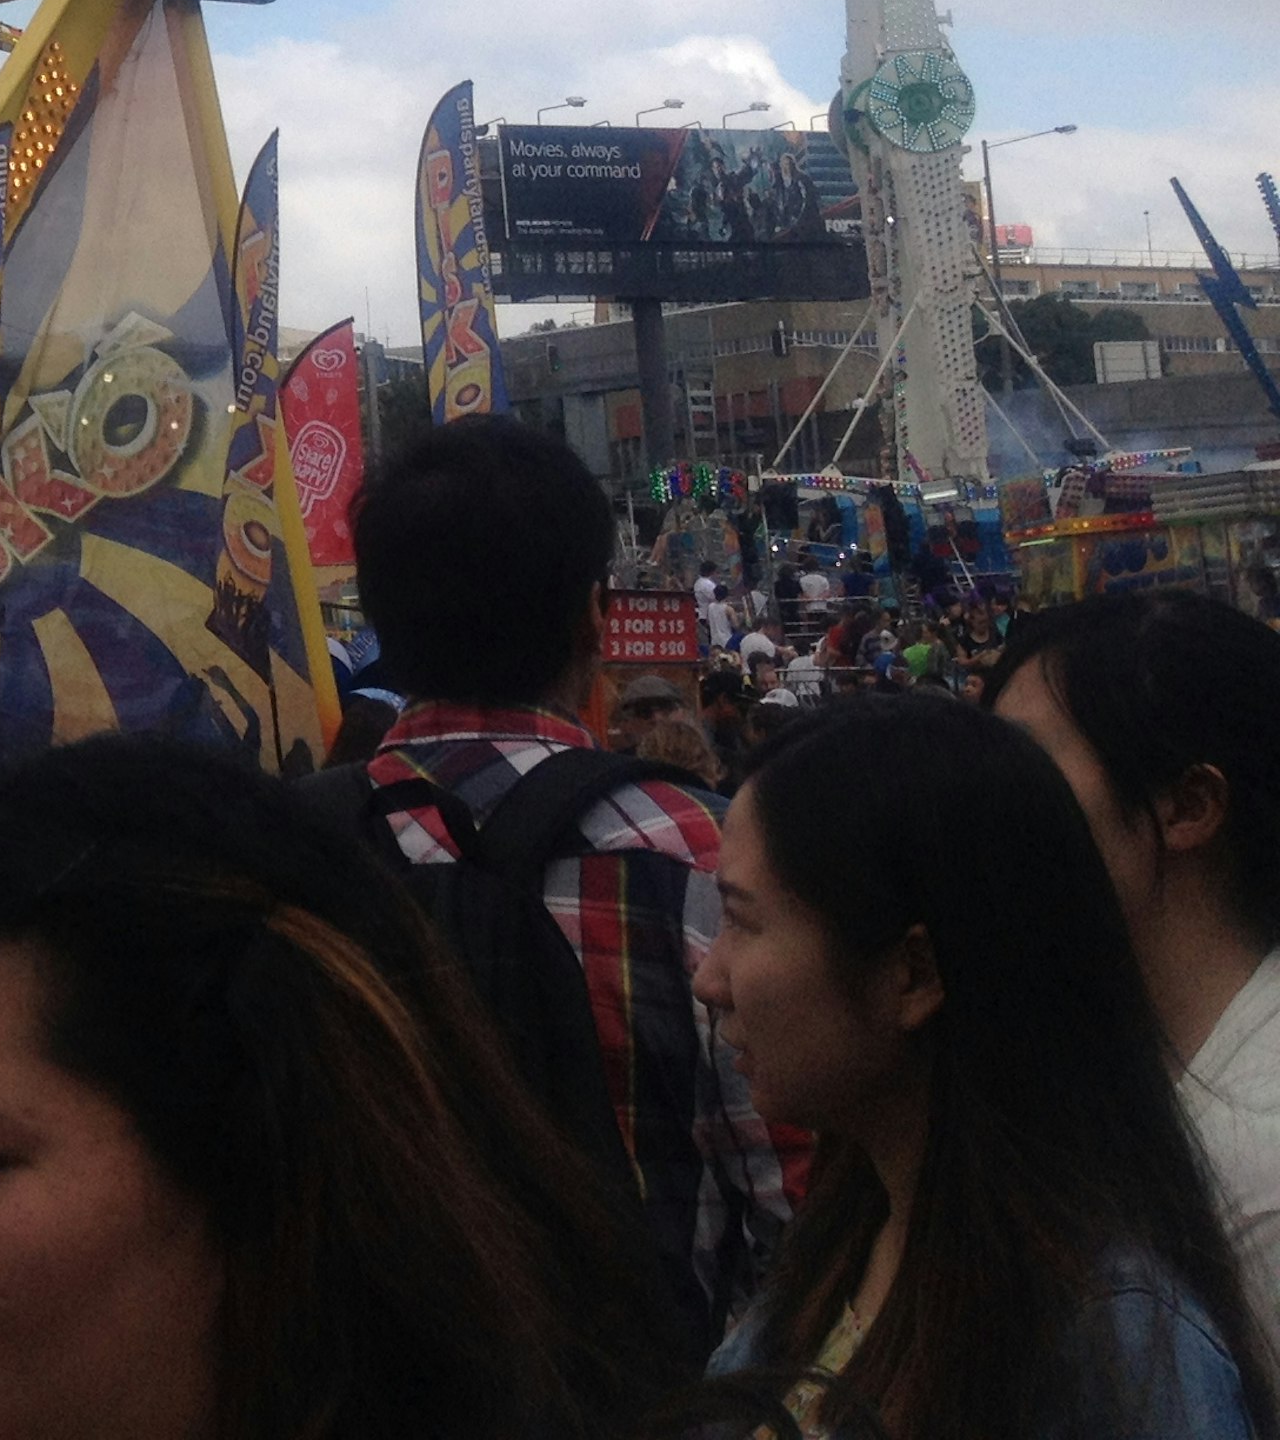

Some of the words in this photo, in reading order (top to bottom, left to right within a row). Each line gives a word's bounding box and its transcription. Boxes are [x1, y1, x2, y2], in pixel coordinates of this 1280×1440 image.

[571, 142, 622, 162] always
[513, 162, 526, 177] at
[529, 164, 562, 180] your
[566, 163, 641, 179] command
[629, 598, 658, 612] FOR
[610, 619, 620, 634] 2
[624, 619, 654, 634] FOR
[659, 619, 685, 634] $15
[610, 640, 620, 656] 3
[625, 641, 655, 656] FOR
[660, 641, 686, 656] $20
